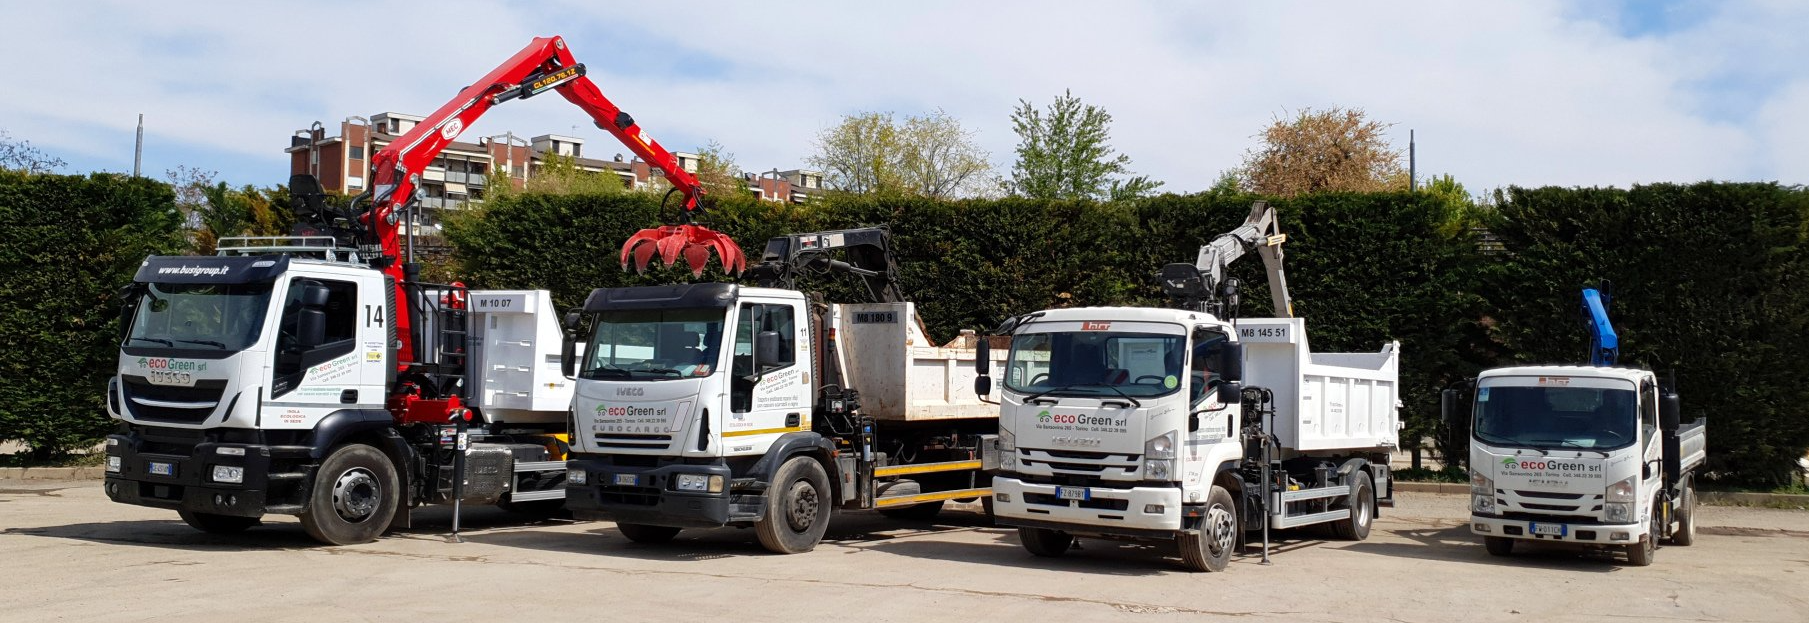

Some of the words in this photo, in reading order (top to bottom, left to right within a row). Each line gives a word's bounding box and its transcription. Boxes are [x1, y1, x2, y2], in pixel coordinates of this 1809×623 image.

[158, 265, 230, 277] www.busigroup.it
[480, 299, 487, 308] M
[490, 299, 499, 308] 10
[501, 299, 511, 308] 07
[365, 304, 384, 328] 14
[857, 313, 869, 323] M8
[870, 313, 885, 323] 180
[887, 313, 893, 322] 9
[800, 327, 807, 337] 11
[1241, 328, 1255, 337] M8
[1257, 328, 1273, 337] 145
[1275, 328, 1286, 337] 51
[148, 358, 167, 369] eco
[168, 358, 195, 371] Green
[197, 361, 207, 371] srl
[319, 363, 332, 372] eco
[331, 355, 351, 367] Green
[766, 375, 778, 384] eco
[778, 369, 795, 379] Green
[616, 387, 644, 396] IVECO
[608, 407, 626, 416] eco
[626, 405, 654, 416] Green
[656, 407, 667, 416] srl
[1053, 414, 1076, 424] eco
[1077, 413, 1112, 426] Green
[1114, 418, 1127, 427] srl
[592, 425, 670, 433] EUROCARGO
[1521, 461, 1546, 470] eco
[1547, 460, 1585, 471] Green
[1588, 463, 1601, 472] srl
